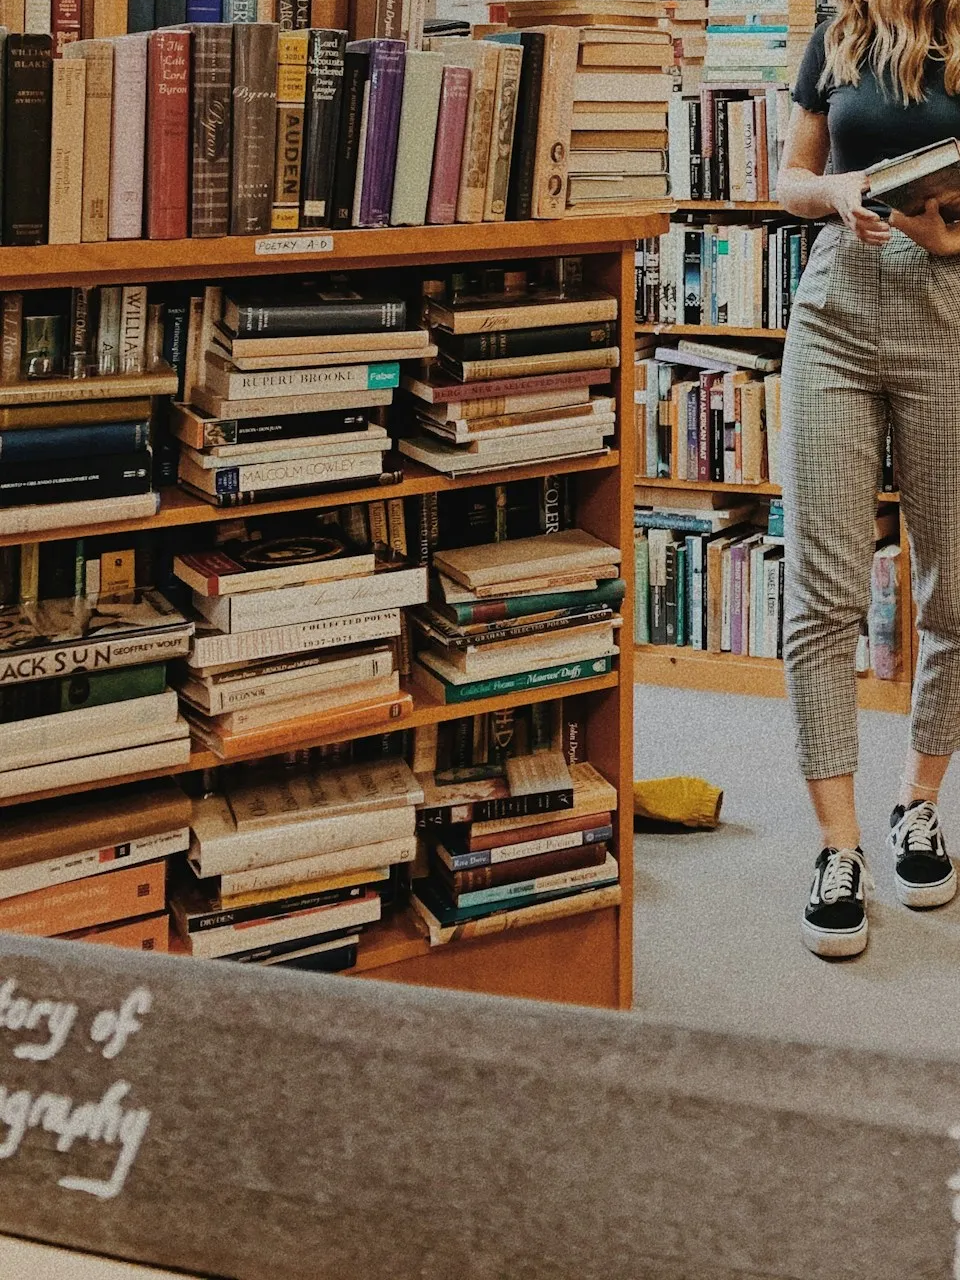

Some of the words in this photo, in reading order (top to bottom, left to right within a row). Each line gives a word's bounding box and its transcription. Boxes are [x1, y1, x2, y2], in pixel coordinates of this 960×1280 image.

[384, 7, 396, 39] Dryden
[166, 40, 184, 51] The
[318, 39, 338, 48] Lord
[10, 48, 51, 57] WILLIAM
[314, 49, 339, 58] Byron
[14, 60, 48, 68] BLAKE
[162, 56, 185, 65] Late
[308, 57, 344, 66] Accounts
[162, 70, 186, 80] Lord
[307, 66, 344, 77] Rendered
[158, 83, 188, 95] Byron
[232, 85, 277, 103] Byron
[200, 100, 225, 157] Byron
[283, 115, 300, 194] AUDEN
[258, 241, 298, 251] POETRY
[306, 239, 327, 248] A-D
[242, 375, 294, 388] RUPERT
[300, 371, 356, 384] BROOKE
[369, 371, 397, 381] Faber
[434, 390, 461, 398] BERG
[472, 385, 493, 394] NEW
[503, 379, 550, 391] SELECTED
[698, 388, 706, 400] AN
[698, 401, 706, 439] AMERICAN
[242, 467, 304, 481] MALCOLM
[306, 460, 357, 475] COWLEY
[302, 617, 363, 631] COLLECTED
[364, 613, 397, 623] POEMS
[587, 611, 607, 620] ECCO
[475, 632, 506, 642] GRAHAM
[510, 624, 545, 635] SELECTED
[547, 620, 570, 629] POEMS
[303, 635, 353, 648] 1937-1971
[54, 646, 111, 672] SUN
[113, 642, 154, 656] GEOFFREY
[157, 638, 182, 649] WOLFF
[459, 684, 493, 697] Collected
[493, 680, 515, 690] Poems
[562, 665, 582, 678] Duffy
[568, 721, 578, 737] John
[500, 845, 541, 859] Selected
[546, 838, 575, 850] Poems
[43, 885, 109, 907] BROWNING
[199, 913, 234, 927] DRYDEN
[91, 986, 152, 1059] of
